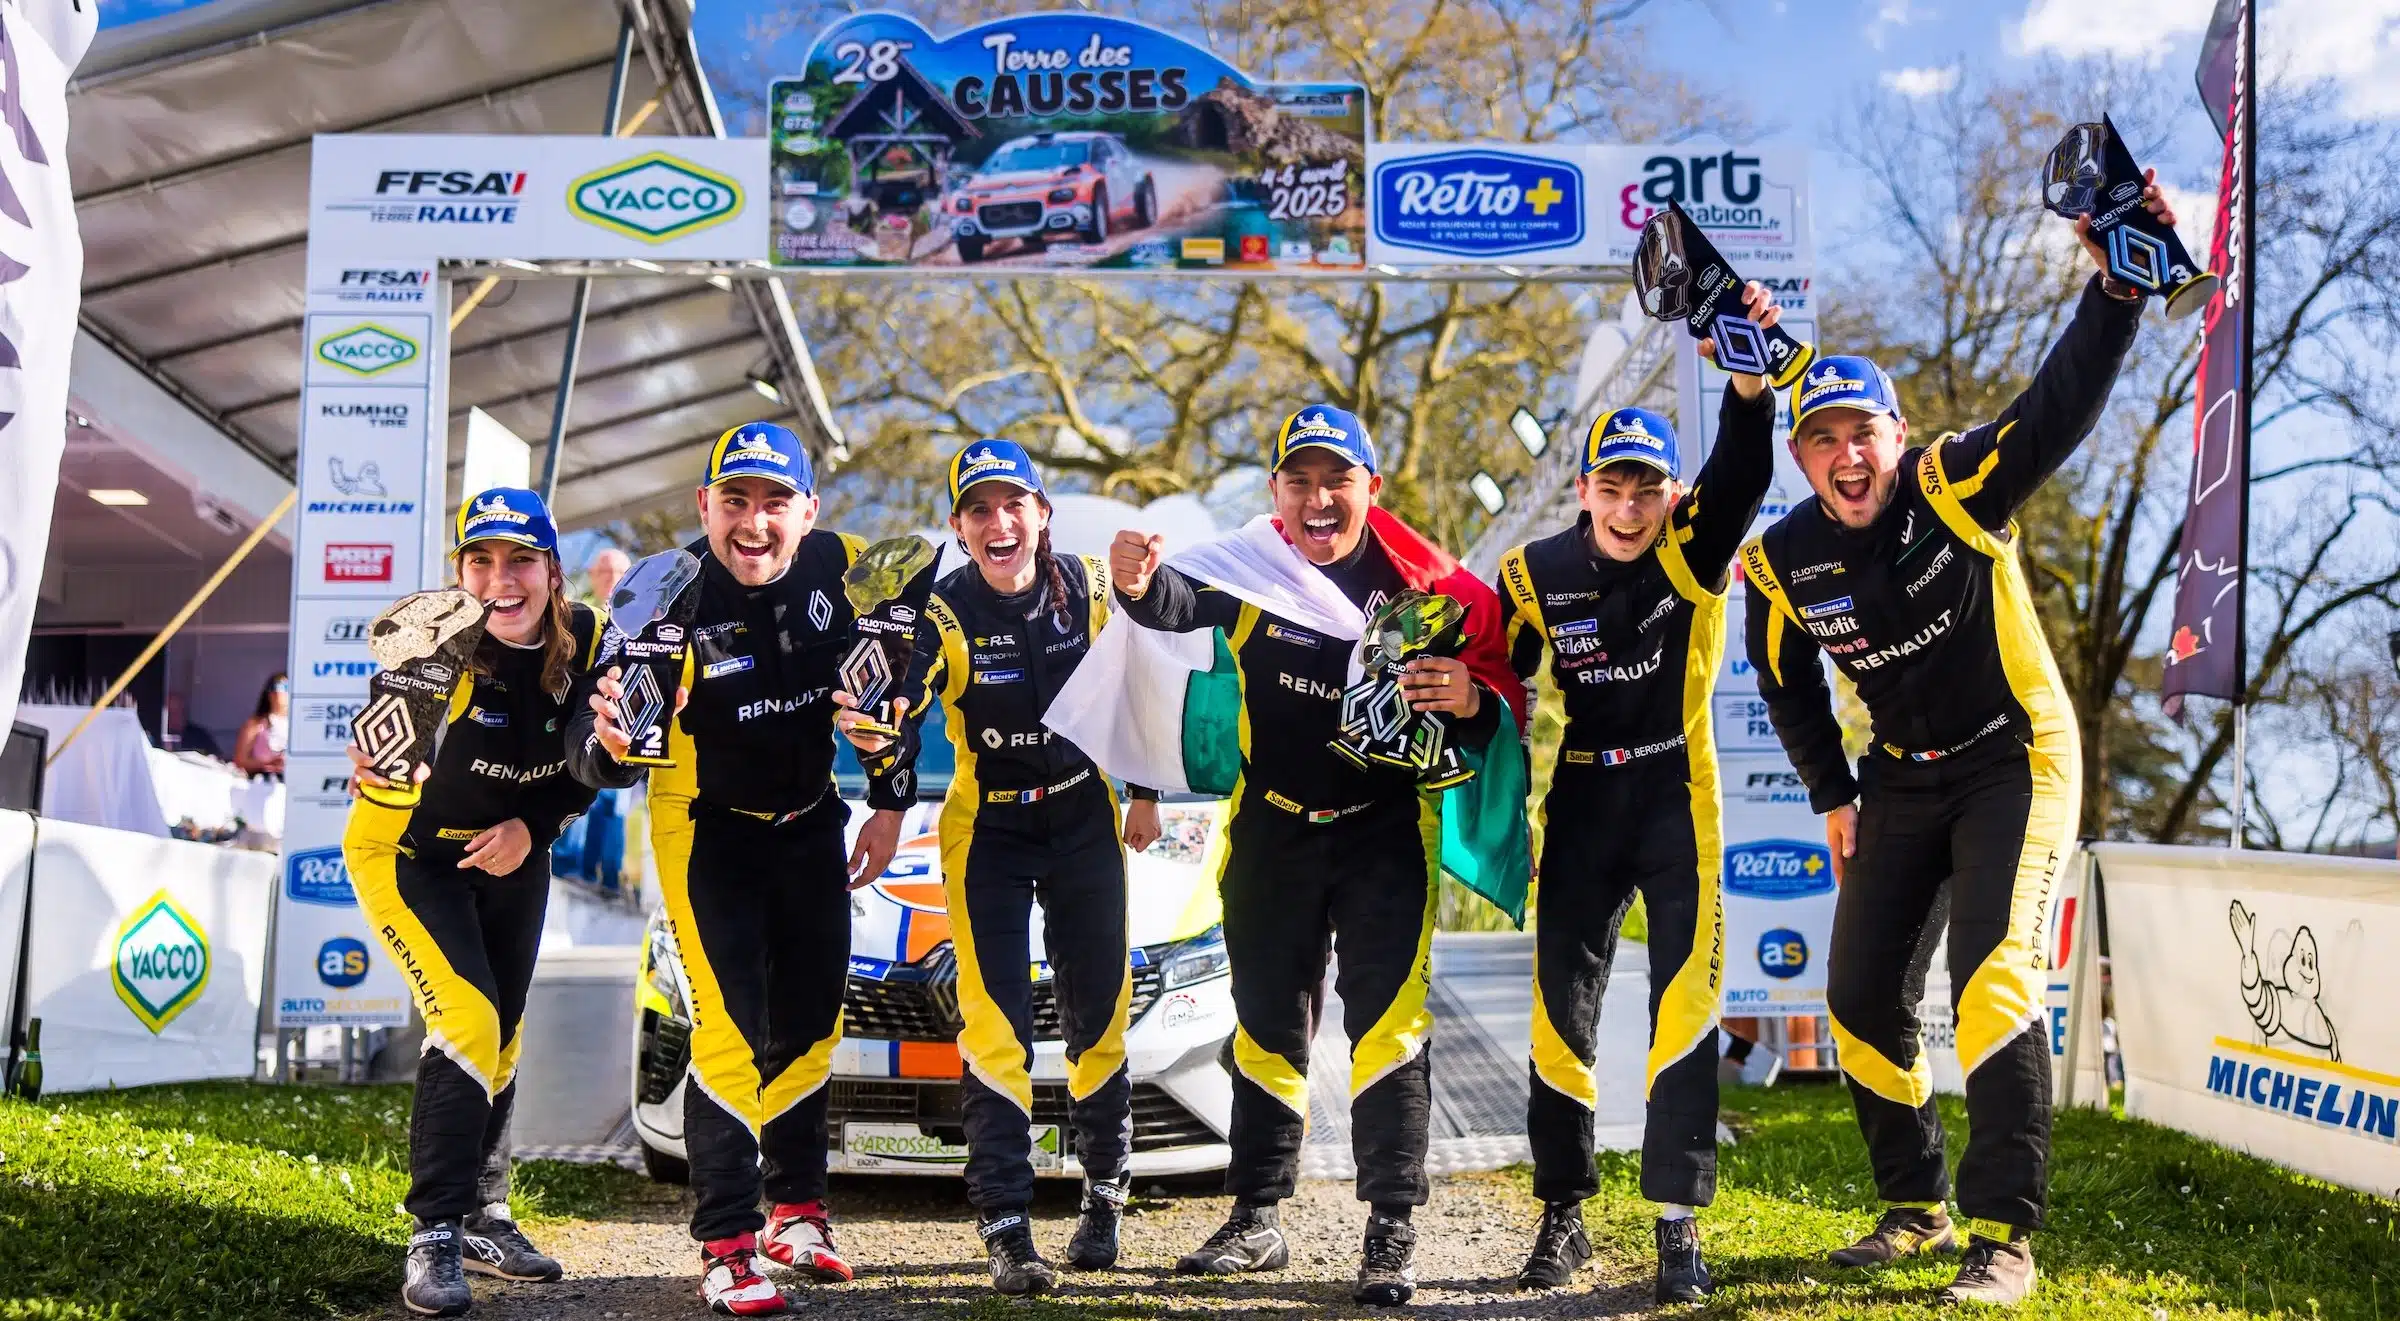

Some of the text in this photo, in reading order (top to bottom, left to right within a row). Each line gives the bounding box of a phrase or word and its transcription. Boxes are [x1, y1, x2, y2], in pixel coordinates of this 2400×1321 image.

[982, 33, 1132, 74] Terre des
[953, 68, 1188, 119] CAUSSES
[375, 171, 508, 195] FFSA
[1642, 150, 1761, 205] art
[597, 186, 718, 211] YACCO
[1268, 184, 1347, 220] 2025
[417, 205, 518, 224] RALLYE
[2090, 195, 2145, 228] CLIOTROPHY
[340, 269, 419, 286] FFSA
[2169, 264, 2193, 285] 3
[366, 291, 424, 303] RALLYE
[1690, 273, 1732, 325] CLIOTROPHY
[332, 343, 405, 361] YACCO
[1768, 338, 1790, 360] 3
[1778, 347, 1800, 373] COPILOTE
[1800, 382, 1865, 409] MICHELIN
[322, 404, 409, 418] KUMHO
[1286, 428, 1349, 447] MICHELIN
[1600, 435, 1666, 452] MICHELIN
[722, 451, 790, 468] MICHELIN
[958, 461, 1017, 486] MICHELIN
[1925, 446, 1943, 497] Sabelt
[307, 502, 415, 514] MICHELIN
[464, 512, 530, 533] MICHELIN
[1746, 545, 1780, 593] Sabelt
[1790, 560, 1843, 579] CLIOTROPHY
[1905, 550, 1955, 599] finadorm
[1094, 557, 1110, 605] Sabelt
[1506, 557, 1537, 605] Sabelt
[1546, 589, 1599, 601] CLIOTROPHY
[1813, 600, 1848, 615] MICHELIN
[857, 617, 916, 635] CLIOTROPHY
[625, 641, 684, 654] CLIOTROPHY
[989, 634, 1016, 647] R.S.
[1045, 632, 1086, 655] RENAULT
[1282, 631, 1317, 645] MICHELIN
[1849, 608, 1952, 671] RENAULT
[1852, 636, 1870, 651] 12
[719, 659, 749, 673] MICHELIN
[1577, 648, 1663, 685] RENAULT
[381, 671, 450, 695] CLIOTROPHY
[1278, 671, 1342, 701] RENA
[738, 686, 829, 723] RENAULT
[878, 700, 890, 722] 1
[645, 725, 663, 749] 2
[1357, 734, 1372, 753] 1
[1398, 734, 1408, 753] 1
[1625, 734, 1687, 761] B. BERGOUNHE
[640, 749, 662, 757] PILOTE
[1443, 747, 1459, 769] 1
[389, 759, 411, 781] 2
[469, 757, 568, 785] RENAULT
[1440, 768, 1461, 779] PILOTE
[1746, 772, 1800, 788] FFS
[1047, 768, 1091, 795] DECLERCK
[992, 791, 1018, 801] Sabe
[1269, 791, 1299, 812] Sabelt
[1769, 791, 1808, 803] RALL
[2030, 849, 2062, 972] RENAULT
[1708, 874, 1724, 990] RENAULT
[130, 942, 196, 982] YACCO
[321, 949, 366, 977] as
[1761, 941, 1804, 967] as
[381, 924, 442, 1017] RENAULT
[2206, 1054, 2399, 1140] MICHELIN
[1975, 1220, 2002, 1236] OMP
